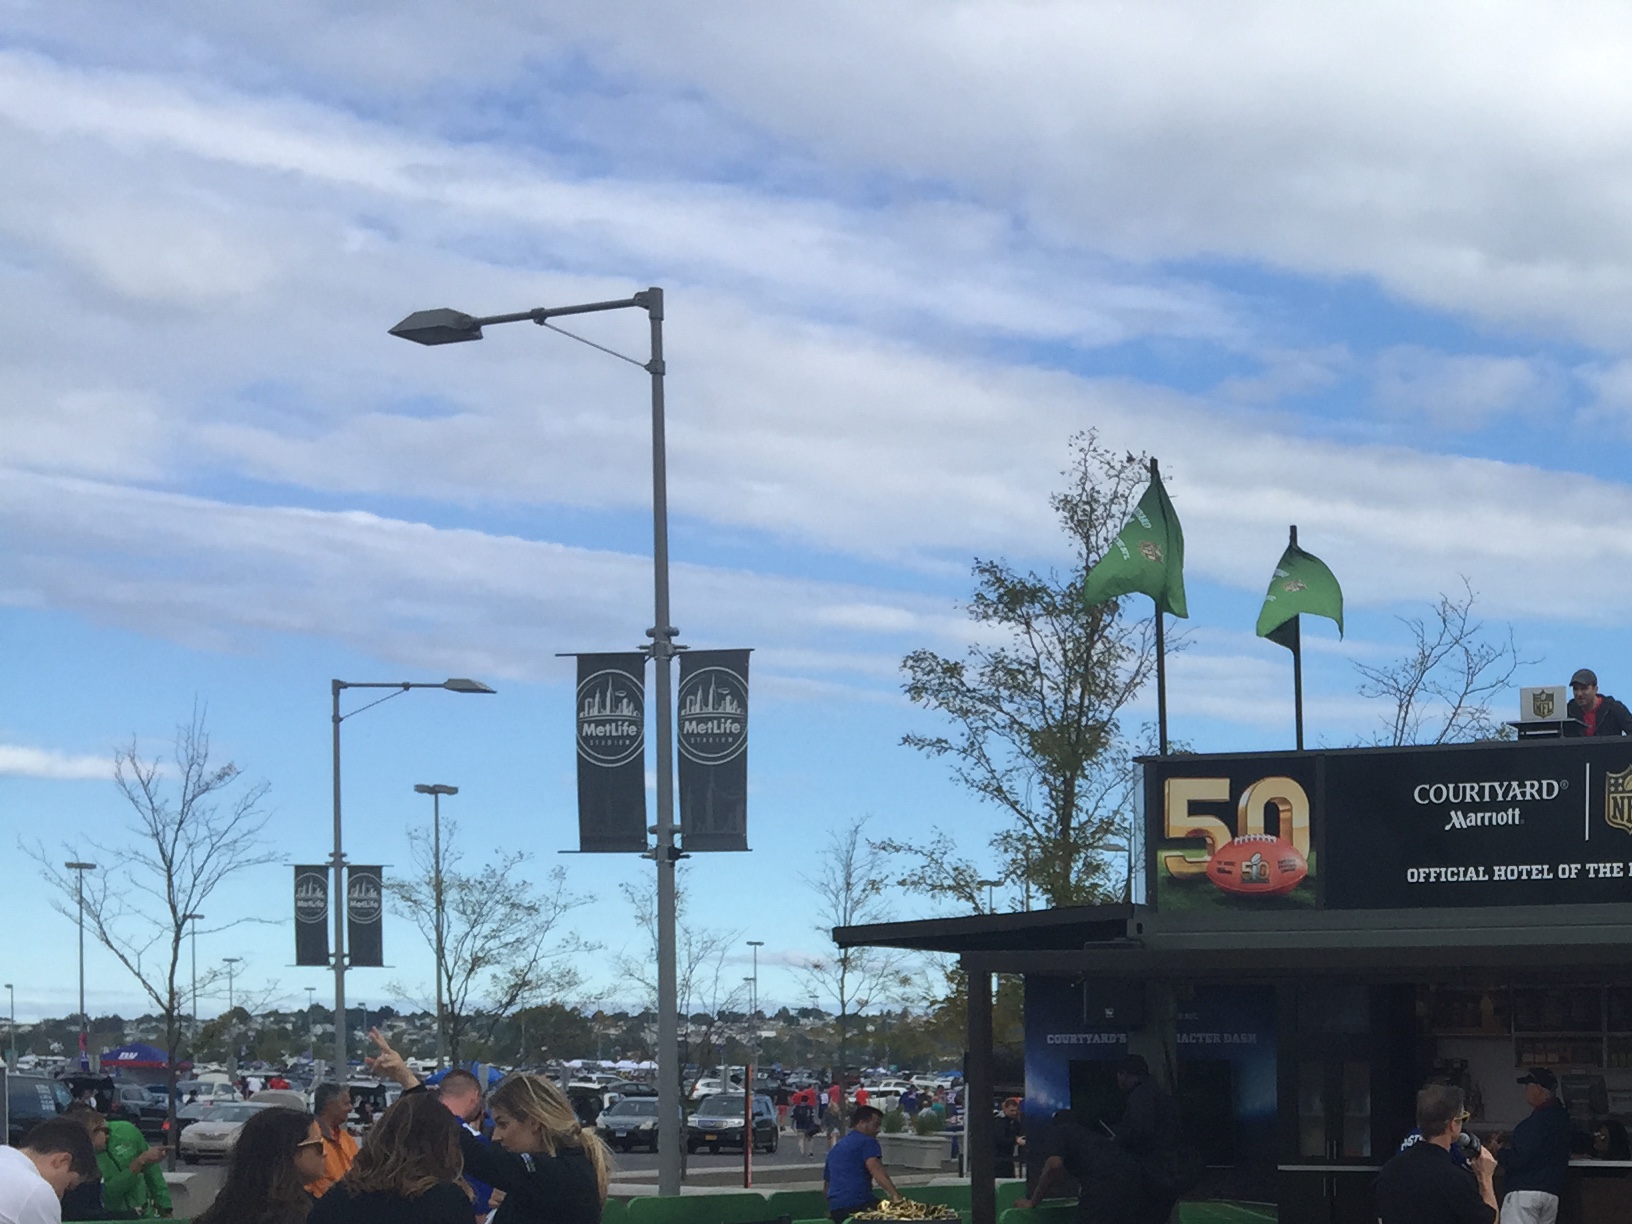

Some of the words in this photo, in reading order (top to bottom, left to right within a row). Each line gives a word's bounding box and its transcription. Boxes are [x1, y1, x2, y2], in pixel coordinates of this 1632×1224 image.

[582, 721, 638, 737] MetLife
[684, 719, 740, 734] MetLife
[1164, 777, 1310, 880] 50
[1444, 807, 1521, 831] Marriott
[1407, 866, 1489, 884] OFFICIAL
[1493, 864, 1553, 881] HOTEL
[1558, 863, 1581, 880] OF
[1586, 862, 1624, 879] THE
